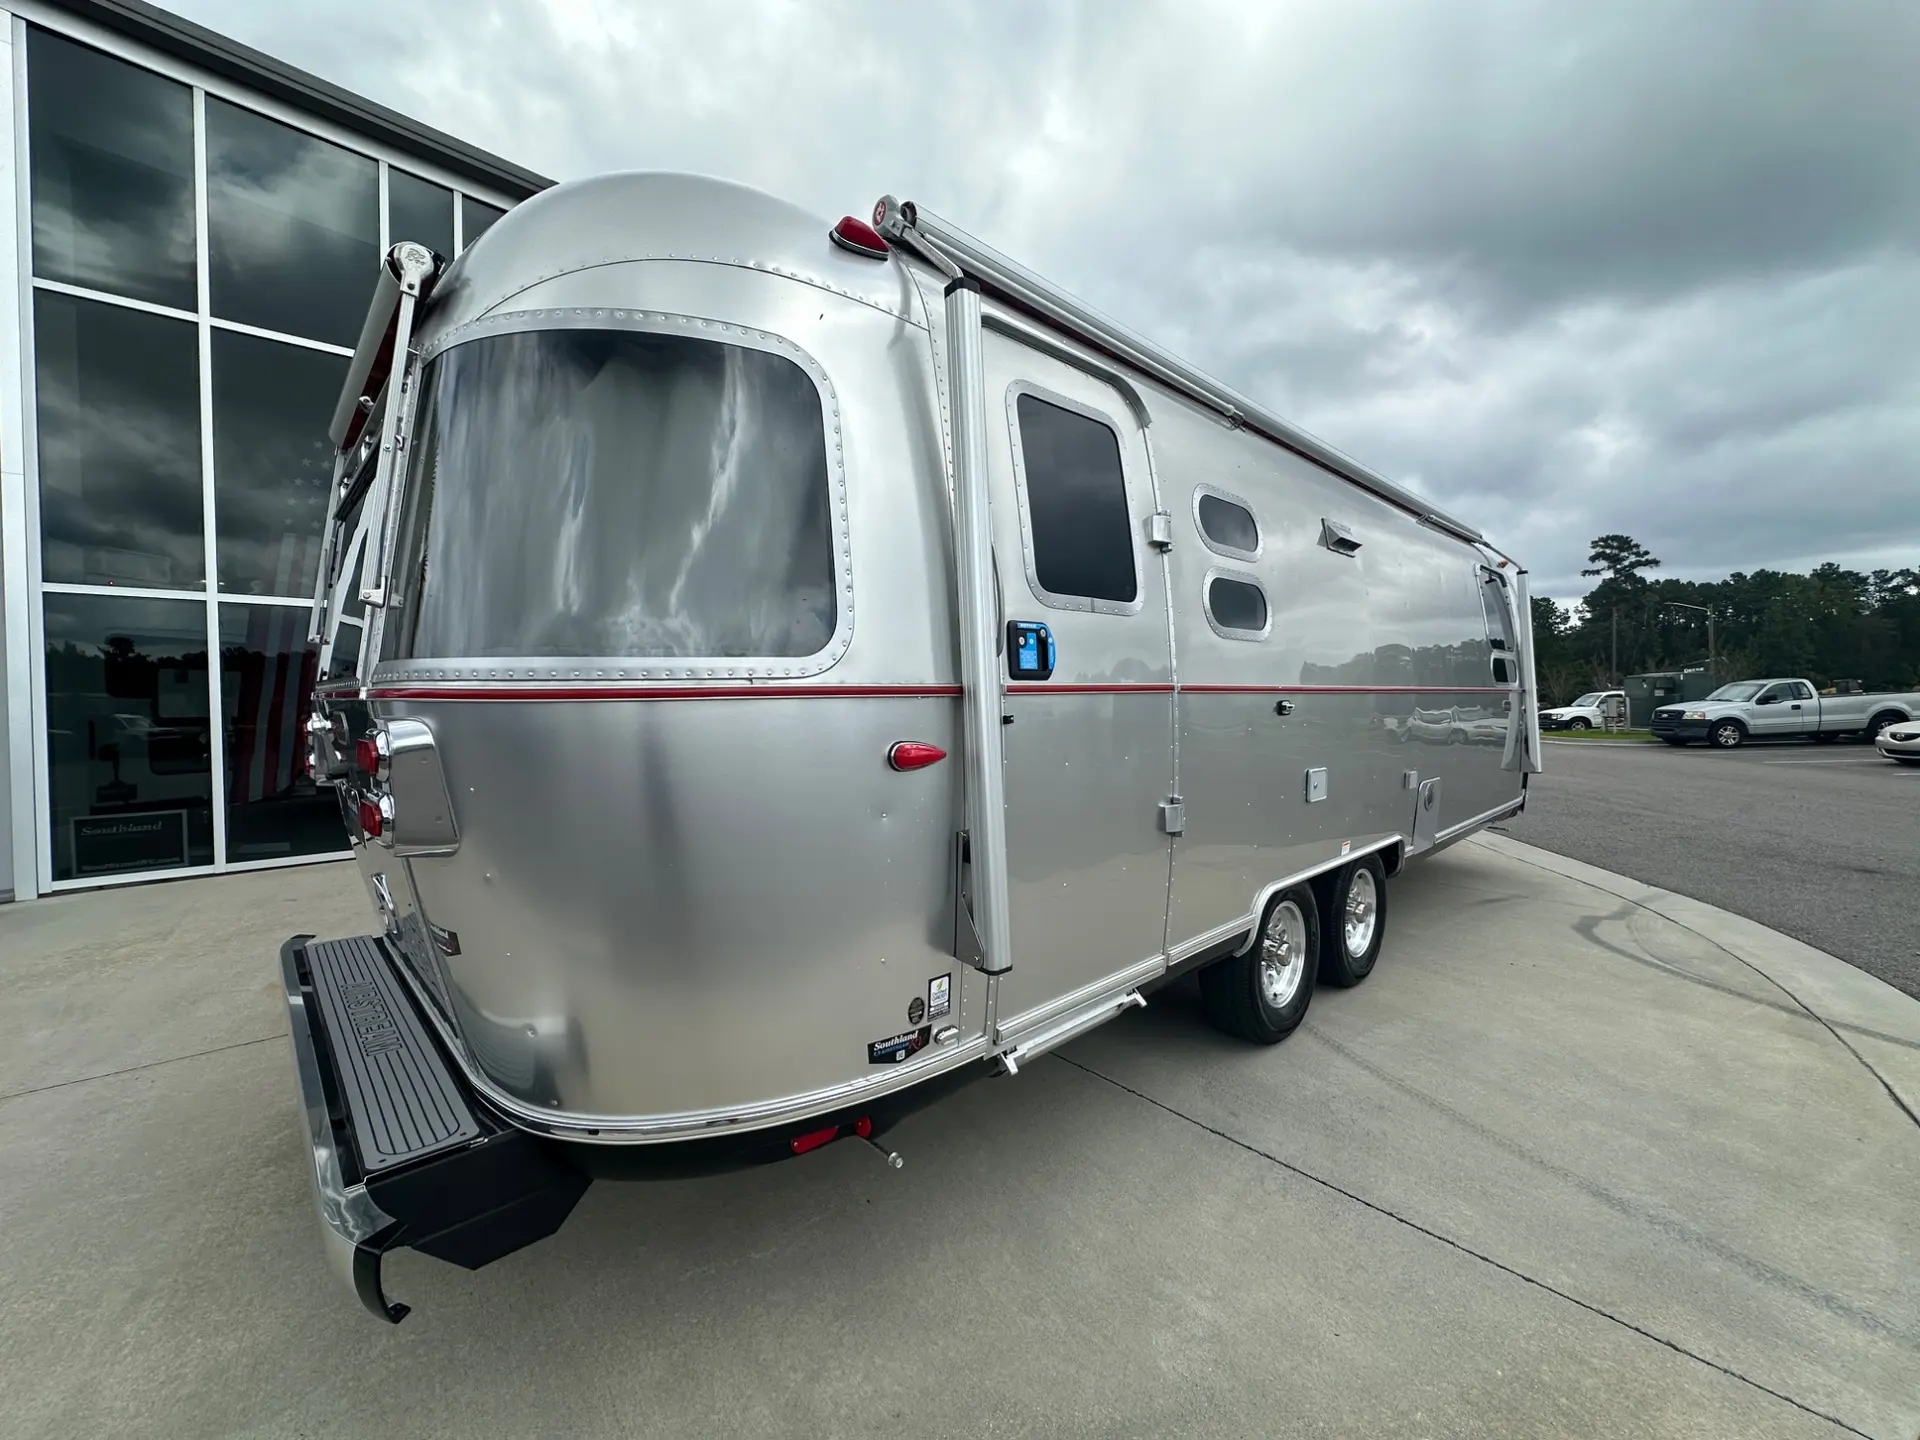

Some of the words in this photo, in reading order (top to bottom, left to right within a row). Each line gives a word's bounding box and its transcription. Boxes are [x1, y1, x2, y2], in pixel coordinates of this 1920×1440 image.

[80, 821, 162, 836] Southland
[340, 981, 404, 1057] AIRSTREAM
[873, 1030, 919, 1051] Southland
